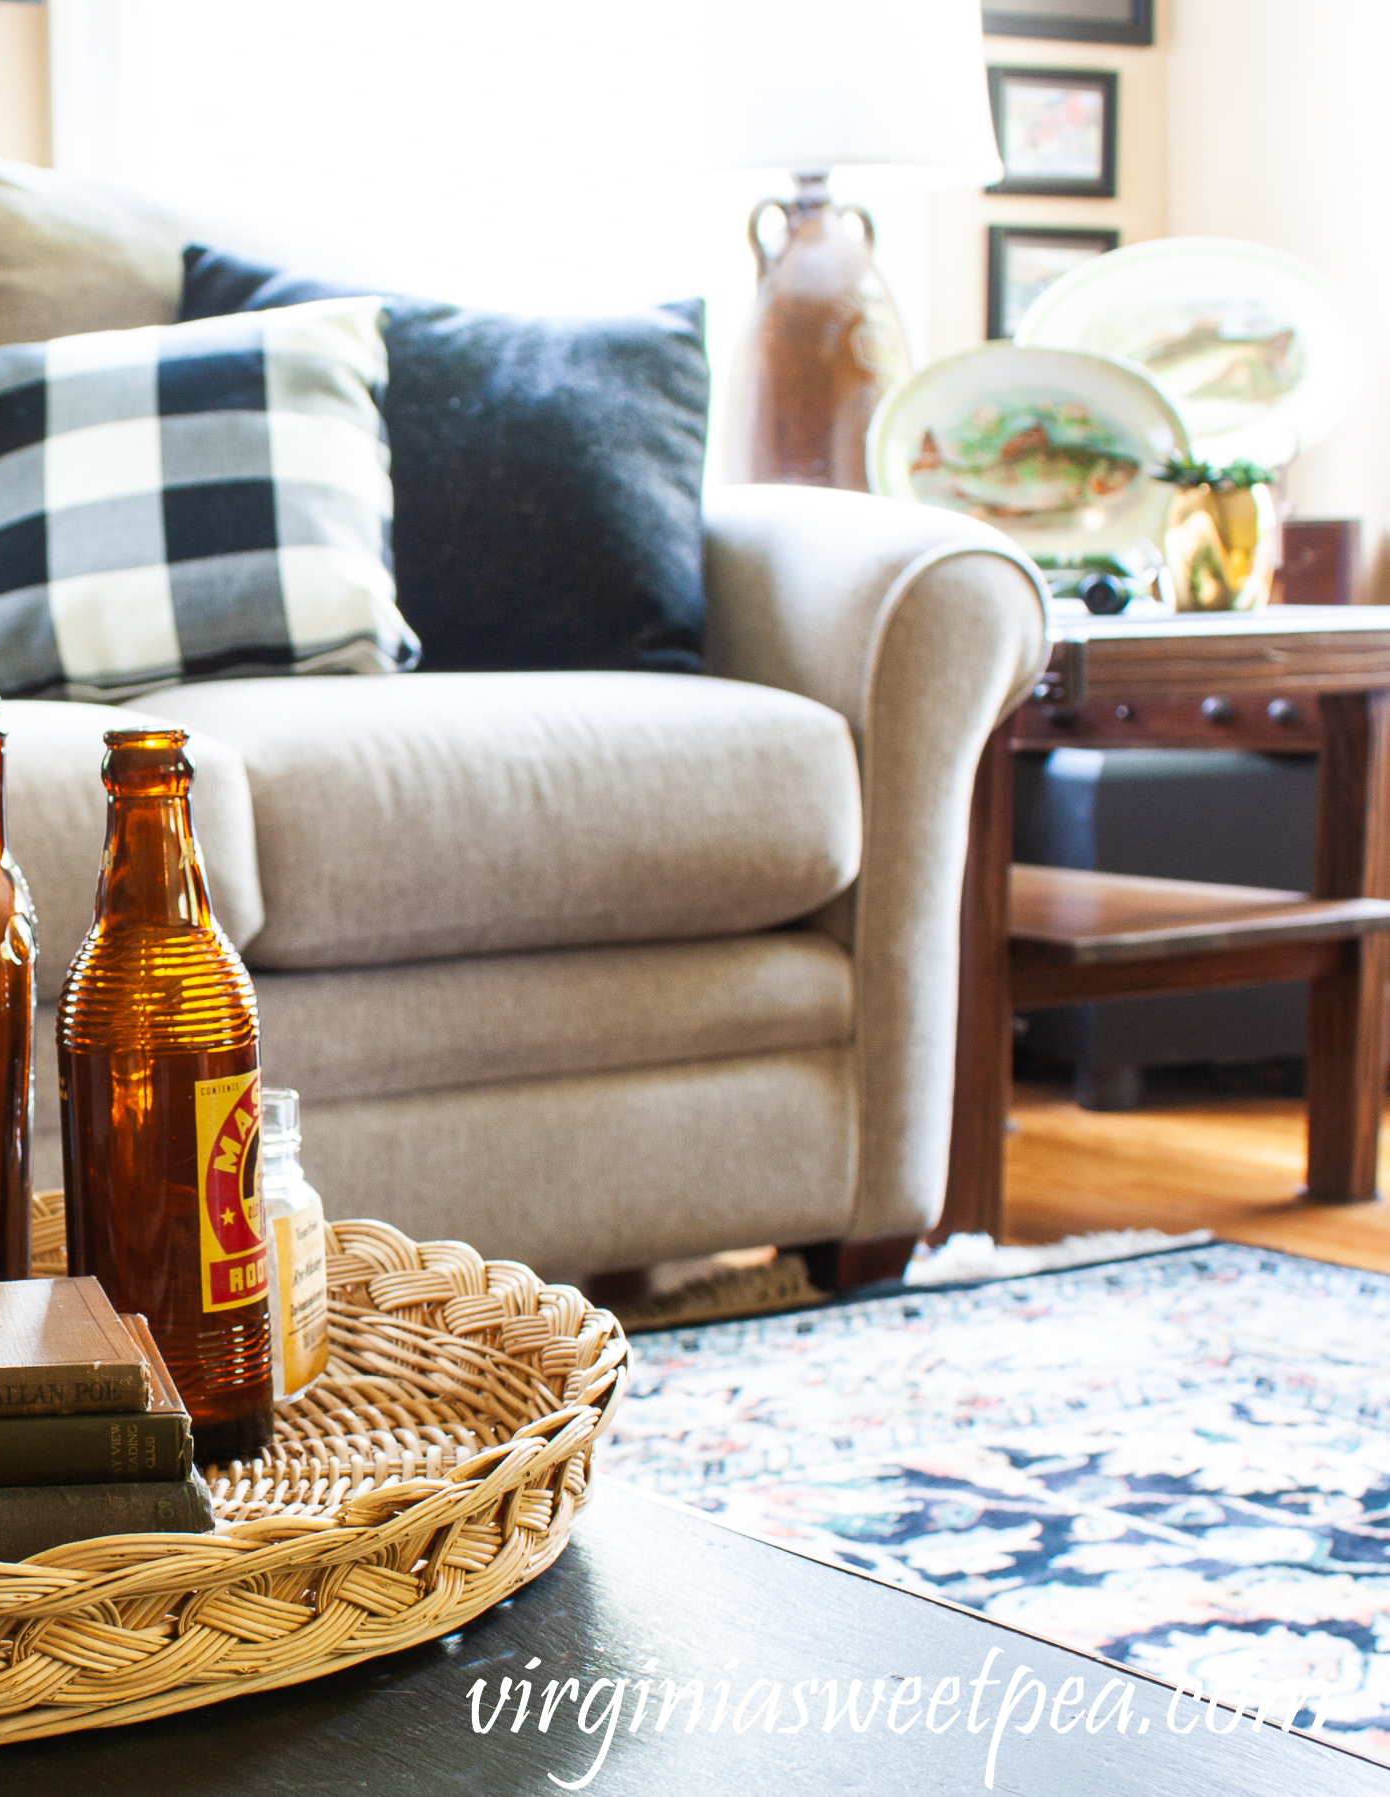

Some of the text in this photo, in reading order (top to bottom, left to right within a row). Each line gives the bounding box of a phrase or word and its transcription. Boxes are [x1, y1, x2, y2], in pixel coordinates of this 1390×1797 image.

[200, 1082, 239, 1096] CONTENTS
[74, 1380, 122, 1402] POE
[110, 1423, 121, 1456] VIEW
[127, 1424, 139, 1475] EADING
[144, 1436, 156, 1469] CLUB
